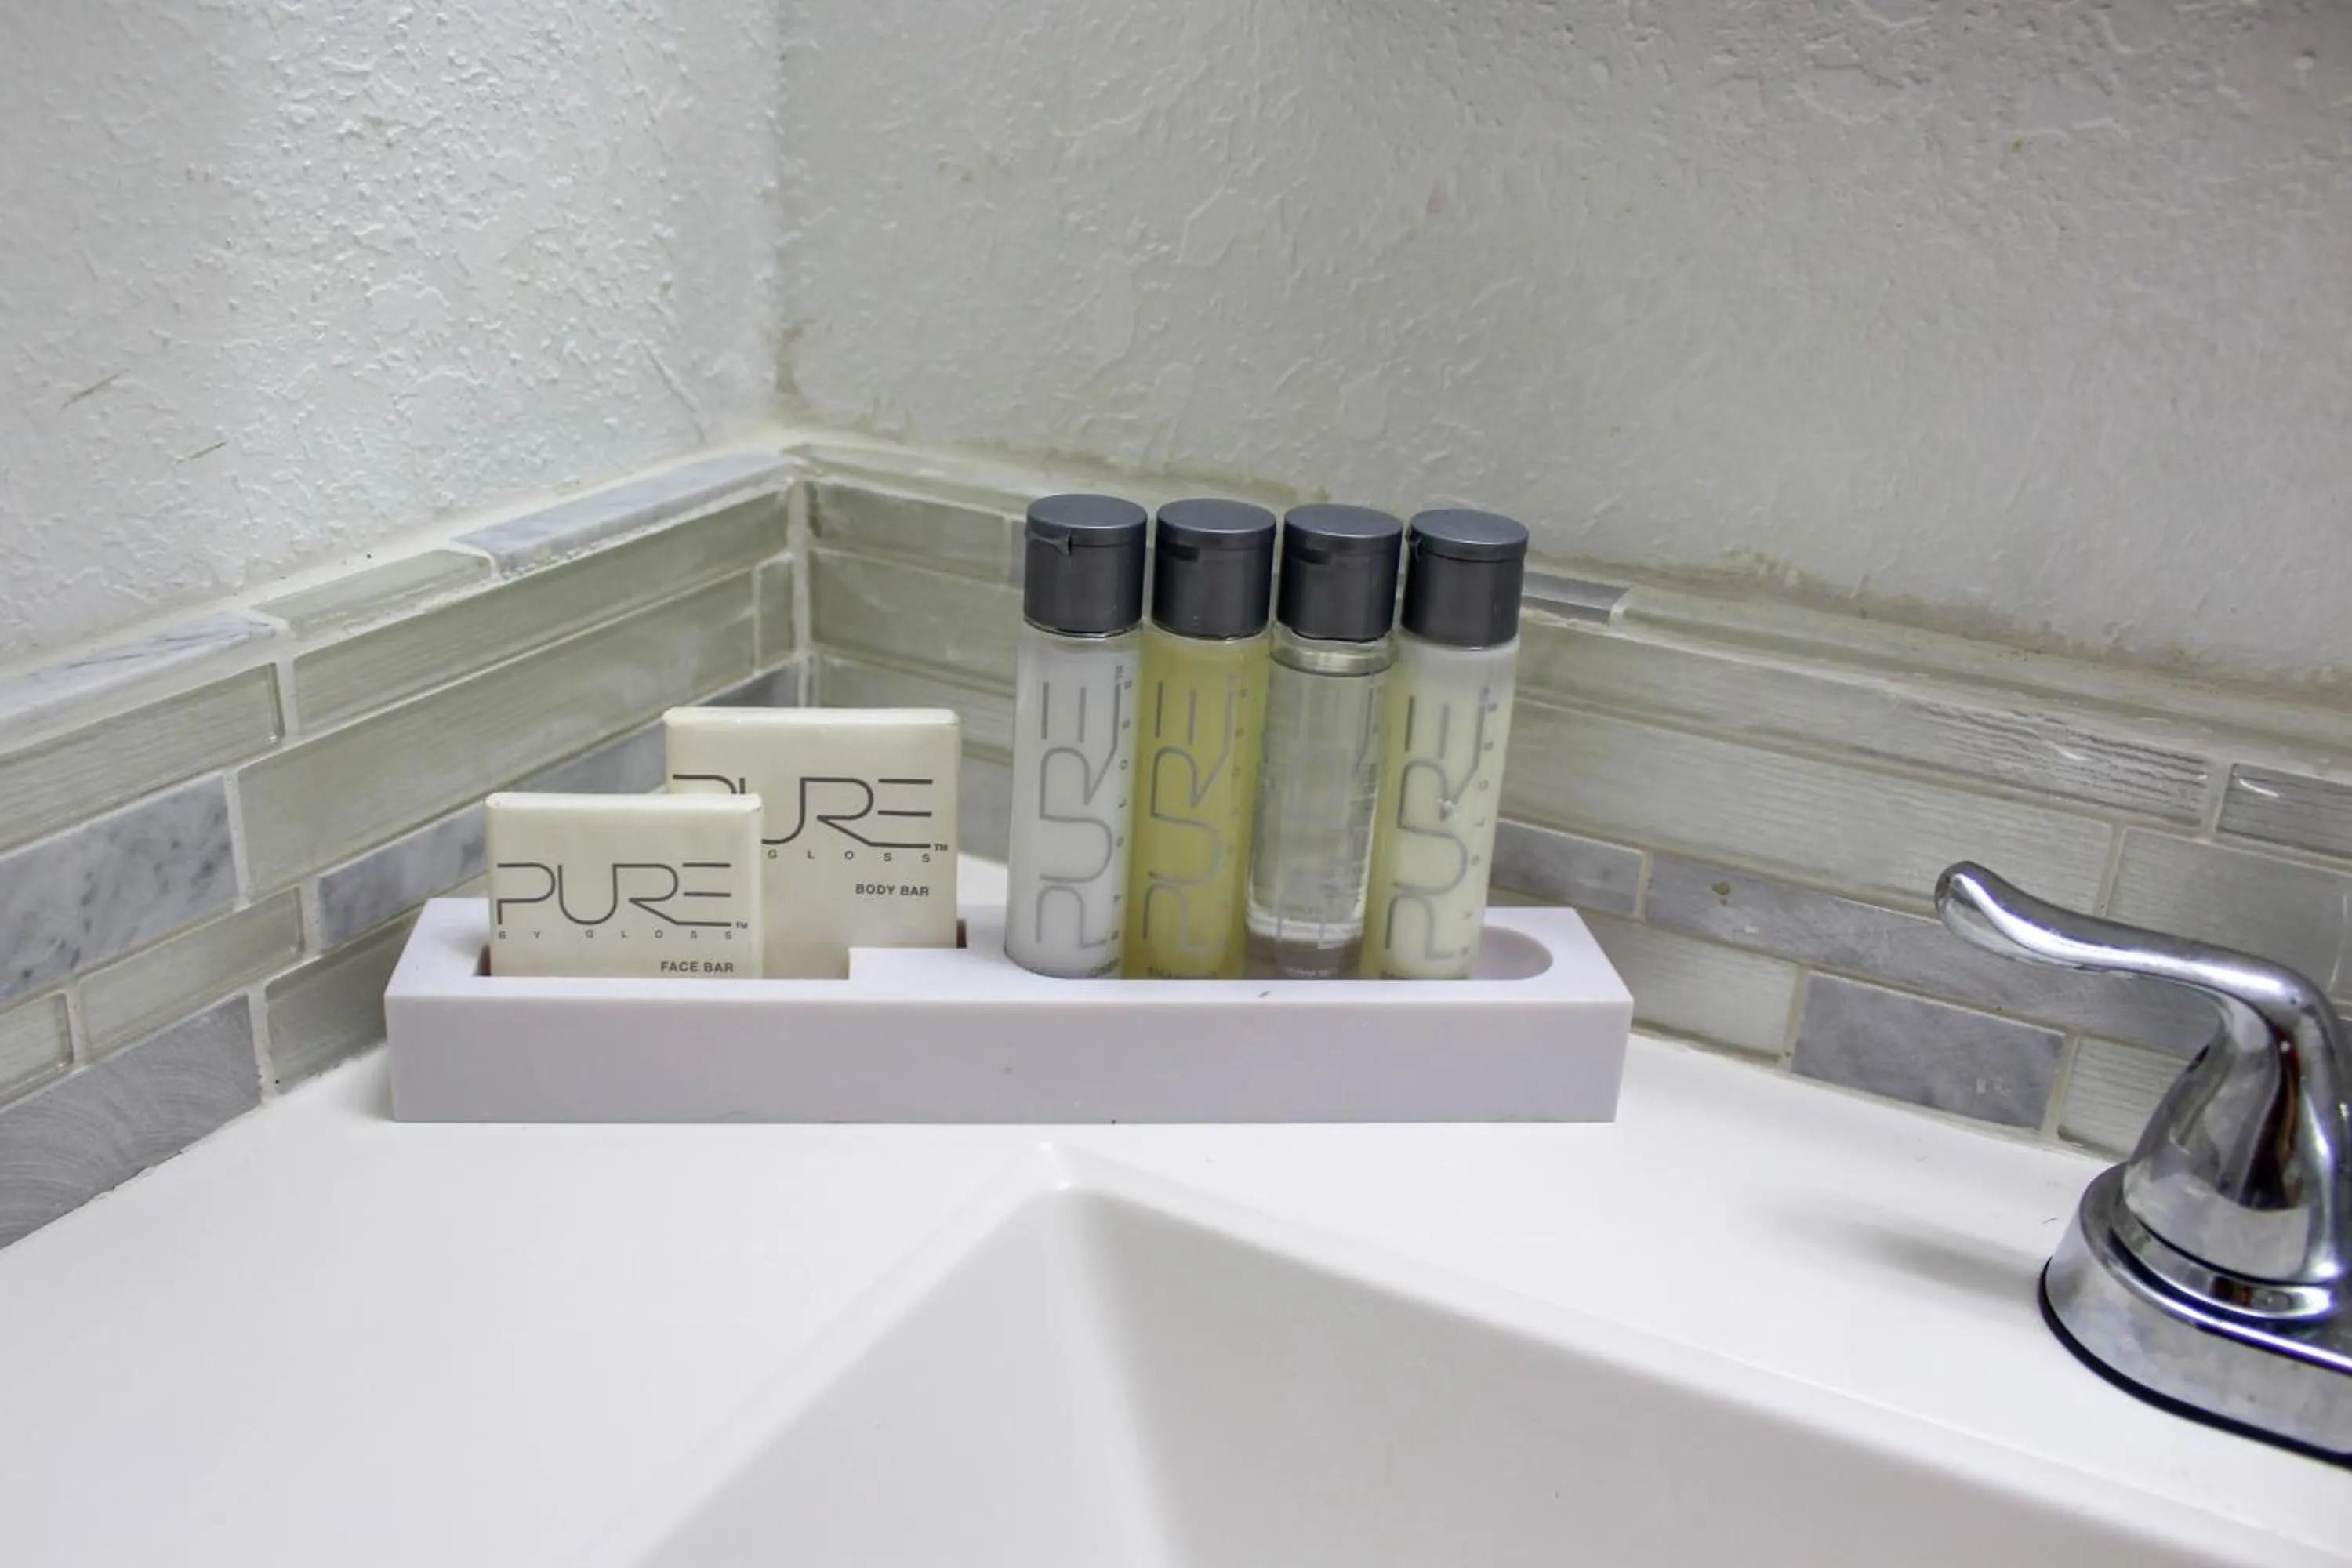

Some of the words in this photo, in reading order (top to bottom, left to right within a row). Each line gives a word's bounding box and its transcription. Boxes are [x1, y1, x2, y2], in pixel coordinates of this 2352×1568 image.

[1034, 680, 1122, 952] PURE
[1141, 680, 1235, 953] PURE
[1383, 695, 1488, 960] PURE
[768, 850, 931, 863] GLOSS
[496, 863, 732, 927] PURE
[855, 884, 896, 896] BODY
[900, 885, 931, 897] BAR
[585, 929, 732, 941] GLOSS
[660, 961, 699, 973] FACE
[703, 961, 735, 974] BAR
